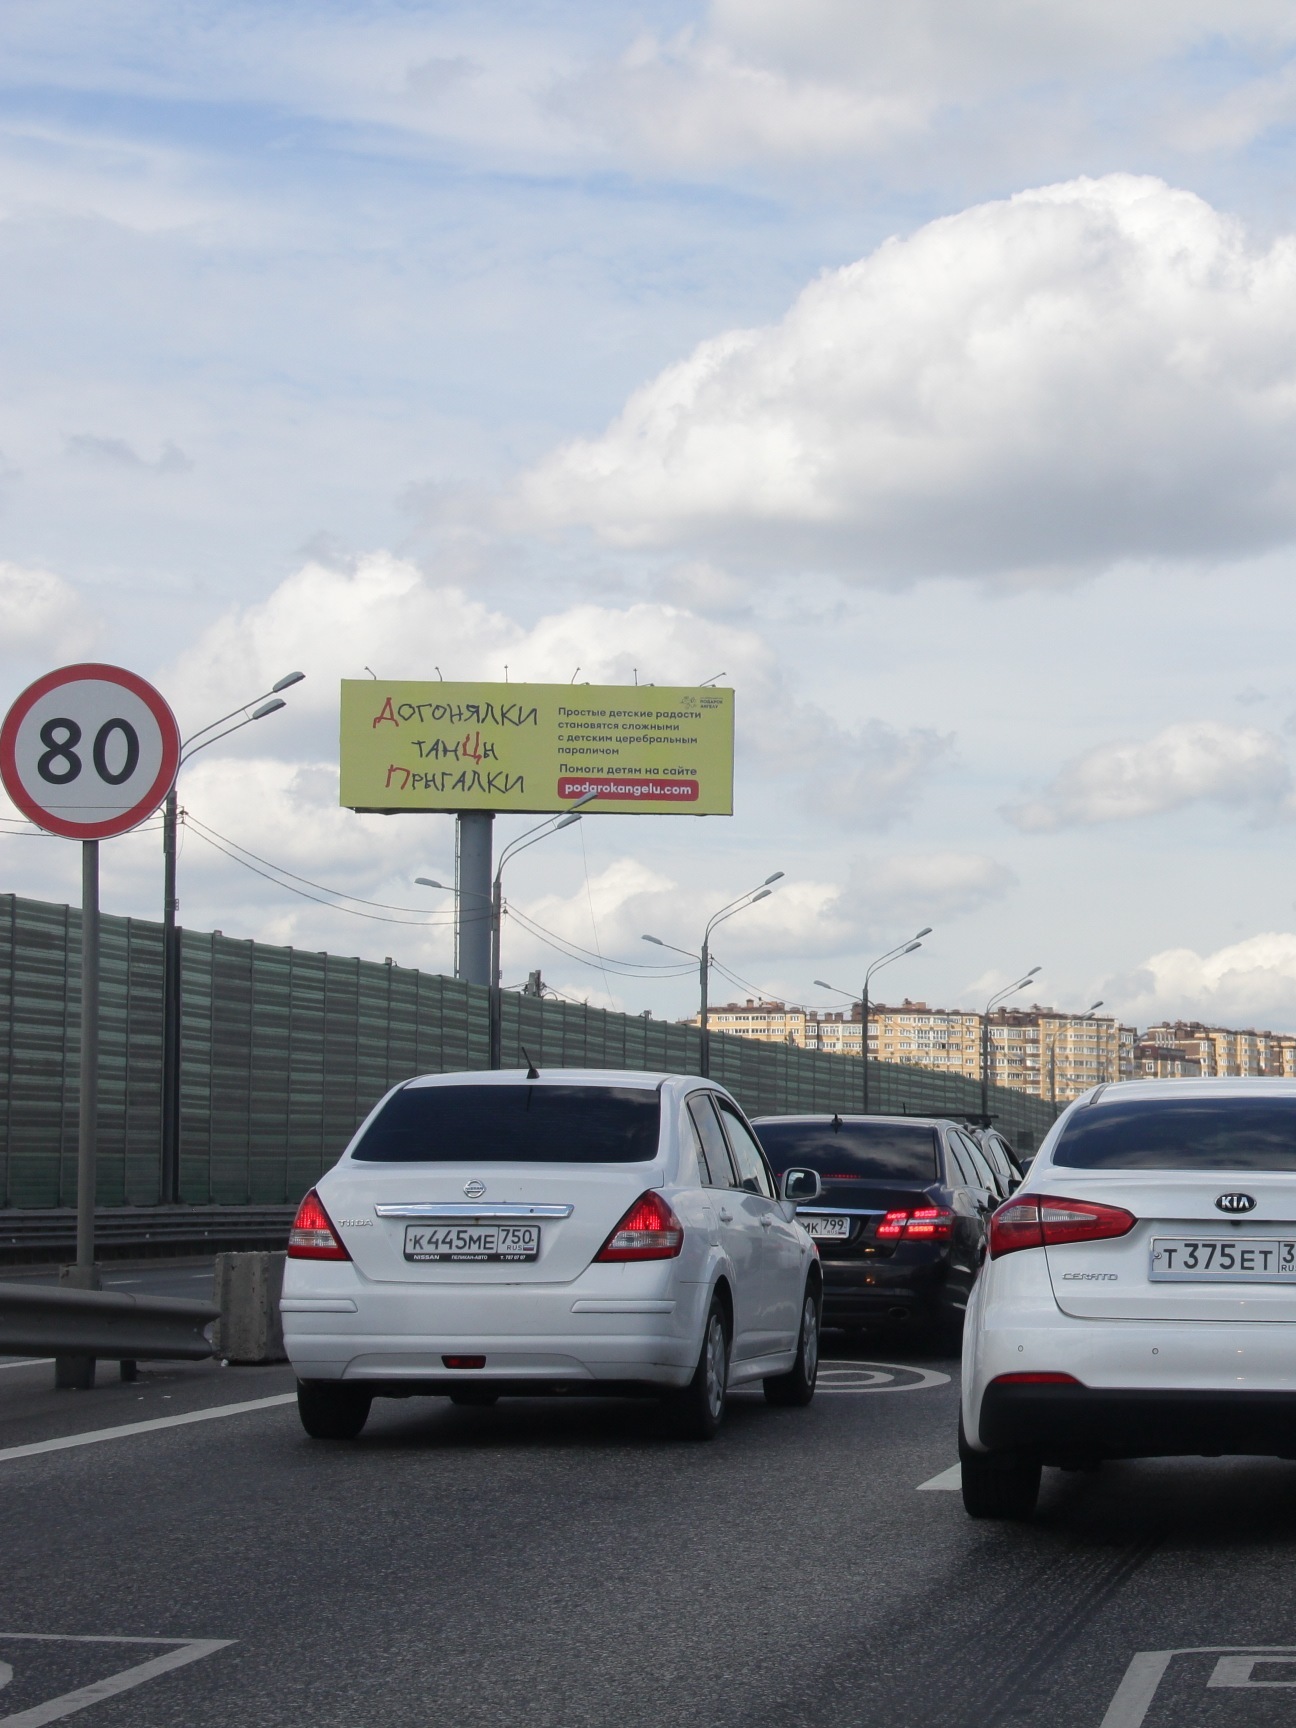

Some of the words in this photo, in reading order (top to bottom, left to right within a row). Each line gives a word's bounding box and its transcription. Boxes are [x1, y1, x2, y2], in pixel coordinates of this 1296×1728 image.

[558, 707, 606, 717] Простые
[609, 709, 653, 718] детские
[656, 711, 702, 720] радости
[557, 721, 619, 730] становятся
[621, 722, 680, 731] сложными
[566, 735, 613, 743] детским
[615, 735, 698, 745] церебральным
[37, 717, 140, 786] 80
[557, 747, 619, 756] параличом
[559, 763, 604, 774] Помоги
[606, 766, 642, 775] детям
[645, 767, 660, 775] на
[662, 766, 698, 776] сайте
[565, 781, 692, 796] podarokangelu.com
[1220, 1196, 1250, 1209] KIA
[337, 1219, 374, 1227] TIIDA
[822, 1218, 845, 1230] 799
[500, 1228, 533, 1245] 750
[1061, 1272, 1119, 1281] CERATO
